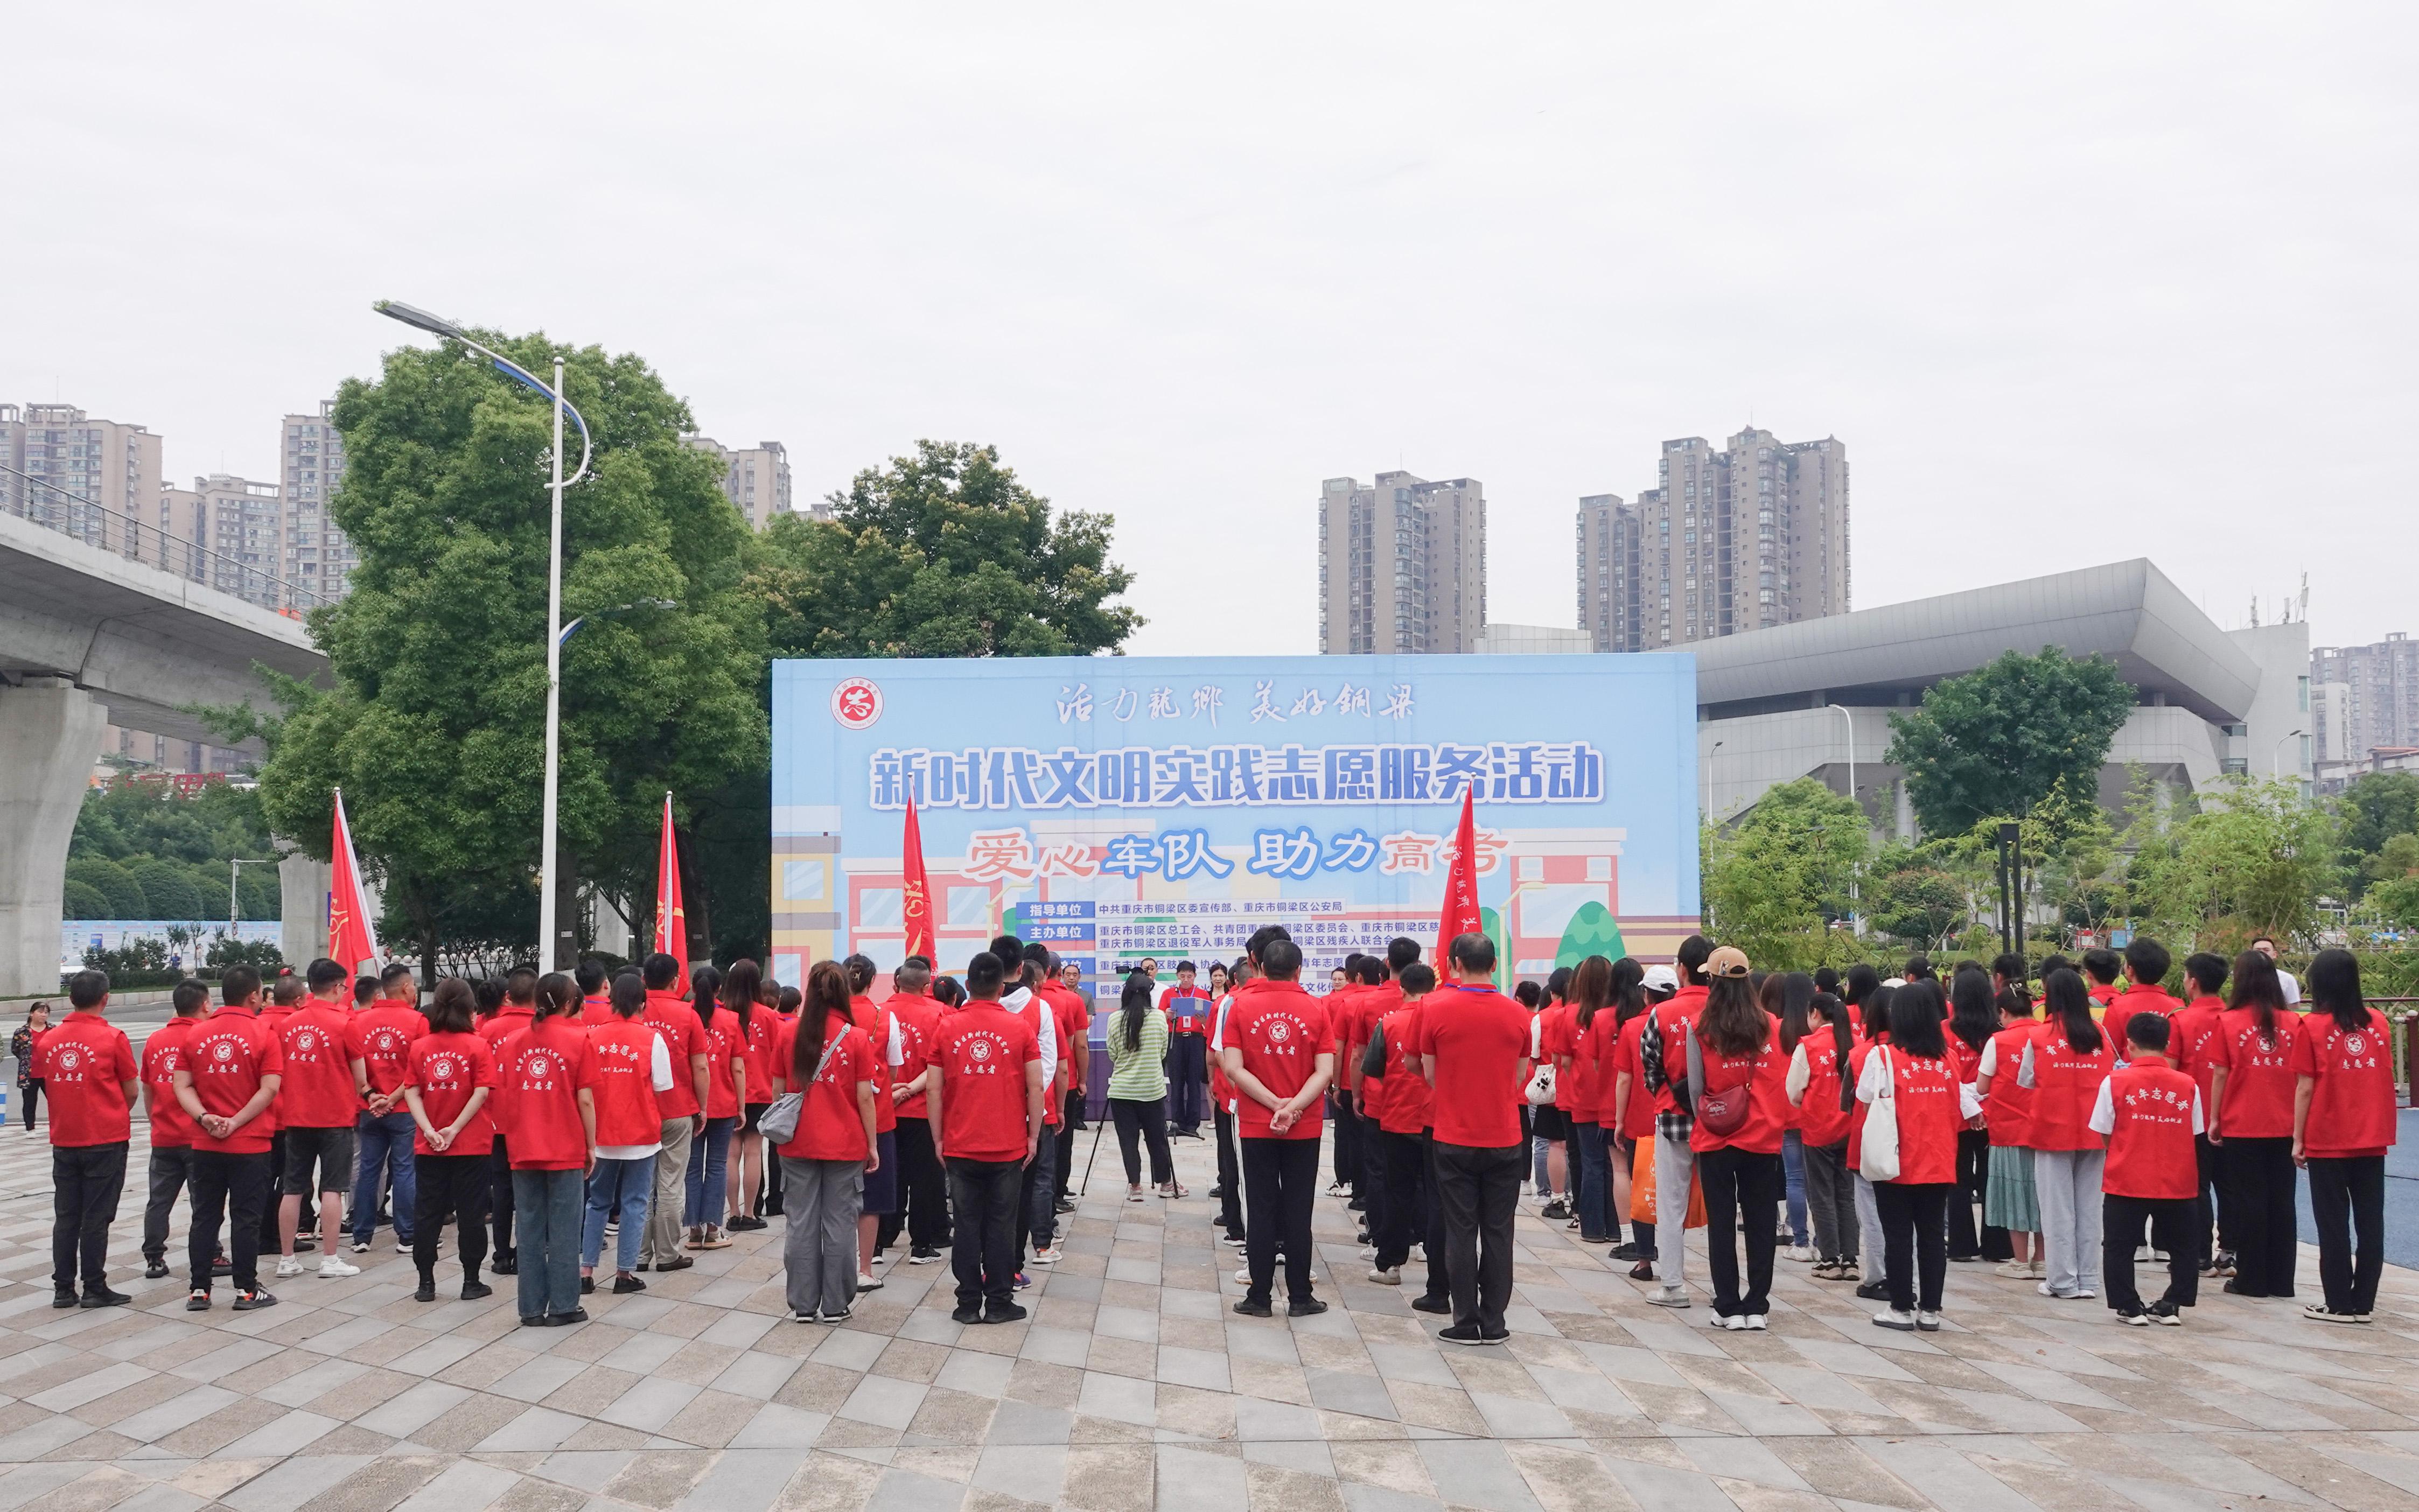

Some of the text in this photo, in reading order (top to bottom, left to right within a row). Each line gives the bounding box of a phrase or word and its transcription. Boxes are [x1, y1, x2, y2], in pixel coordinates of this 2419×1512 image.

[873, 744, 1599, 804] 新时代文明实践志愿服务活动
[966, 828, 1232, 880] 爱心车队
[1030, 904, 1082, 916] 指导单位
[1030, 926, 1082, 939] 主办单位
[1100, 921, 1439, 936] 重庆市铜梁区总工会、共青团重铜梁区委员会、重庆市铜梁区慈
[1901, 1058, 1952, 1080] 青年志愿者
[2125, 1087, 2189, 1111] 青年志愿者
